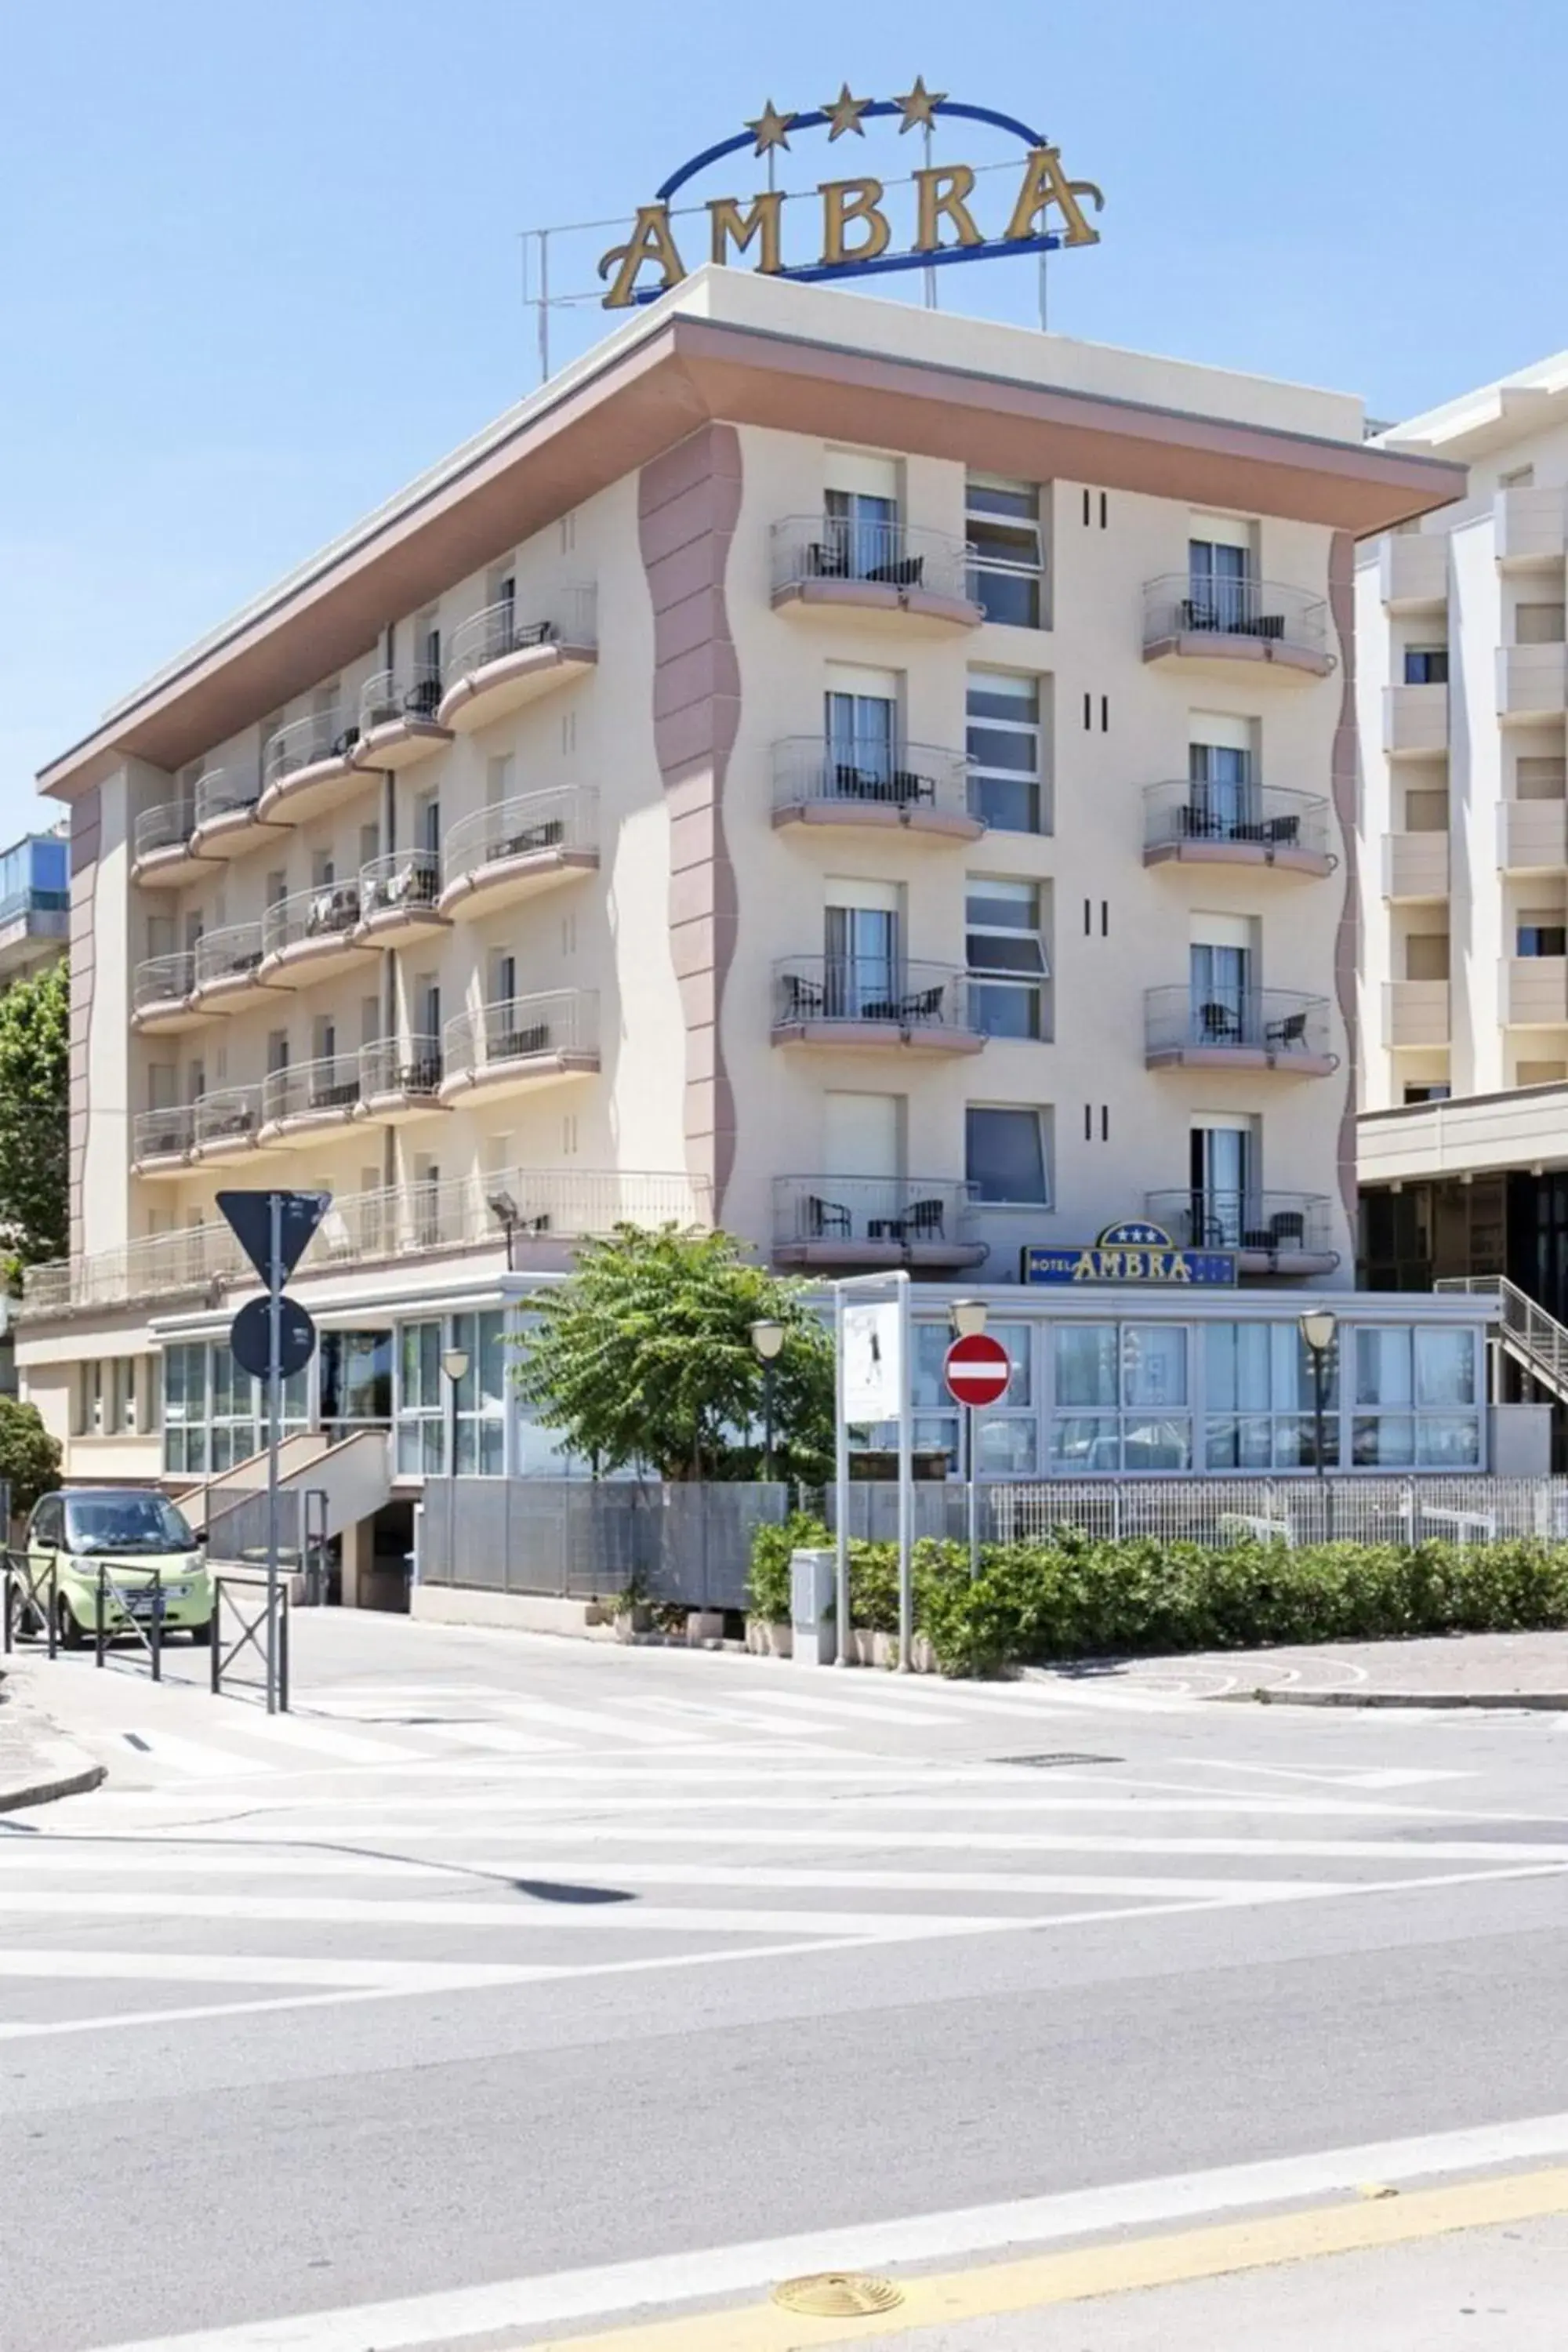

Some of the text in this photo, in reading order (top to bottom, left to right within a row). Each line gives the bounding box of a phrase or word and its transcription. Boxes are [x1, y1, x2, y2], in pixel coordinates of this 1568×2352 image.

[597, 147, 1104, 310] AMBRA
[1031, 1250, 1192, 1283] HOTEL AMBRA
